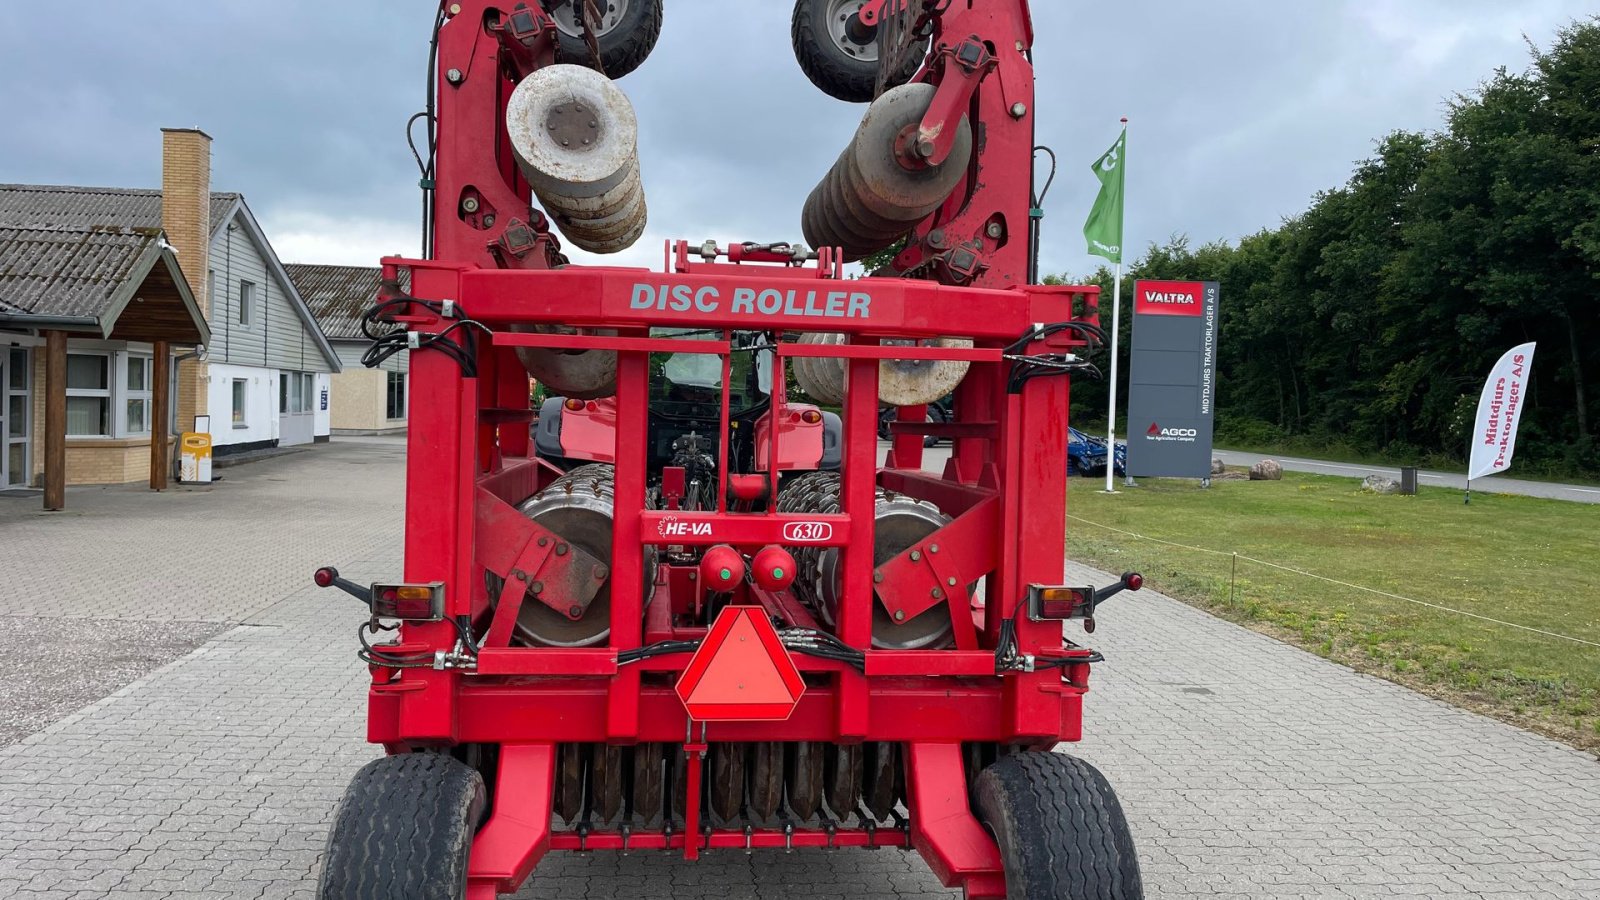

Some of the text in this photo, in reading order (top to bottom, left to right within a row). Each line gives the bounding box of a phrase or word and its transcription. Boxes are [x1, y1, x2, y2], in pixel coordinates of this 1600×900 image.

[630, 283, 872, 318] DISC ROLLER
[1145, 291, 1194, 304] VALTRA
[1202, 288, 1215, 414] MIDTDJURS TRAKTORLAGER A/S
[1485, 377, 1506, 445] Midtdjurs
[1493, 354, 1524, 468] Traktorlager A/S
[1161, 428, 1197, 437] AGCO
[665, 522, 713, 535] HE-VA
[792, 523, 823, 539] 630
